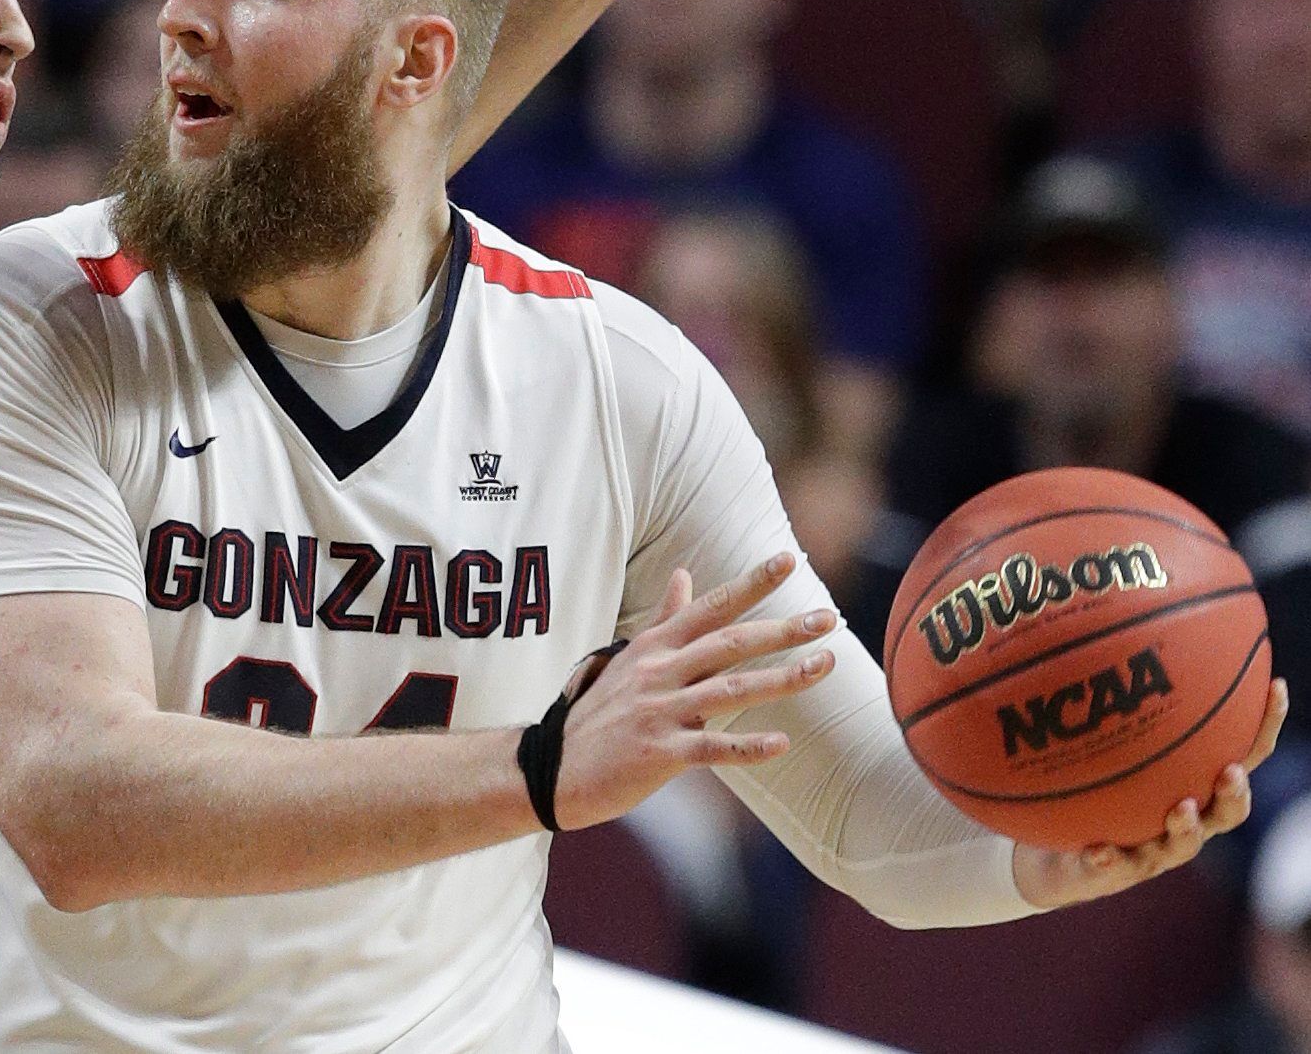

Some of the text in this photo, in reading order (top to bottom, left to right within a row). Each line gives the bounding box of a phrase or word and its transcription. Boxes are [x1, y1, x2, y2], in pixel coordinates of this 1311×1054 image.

[145, 519, 551, 639] GONZAGA
[918, 542, 1168, 666] Wilson
[997, 647, 1173, 758] NCAA
